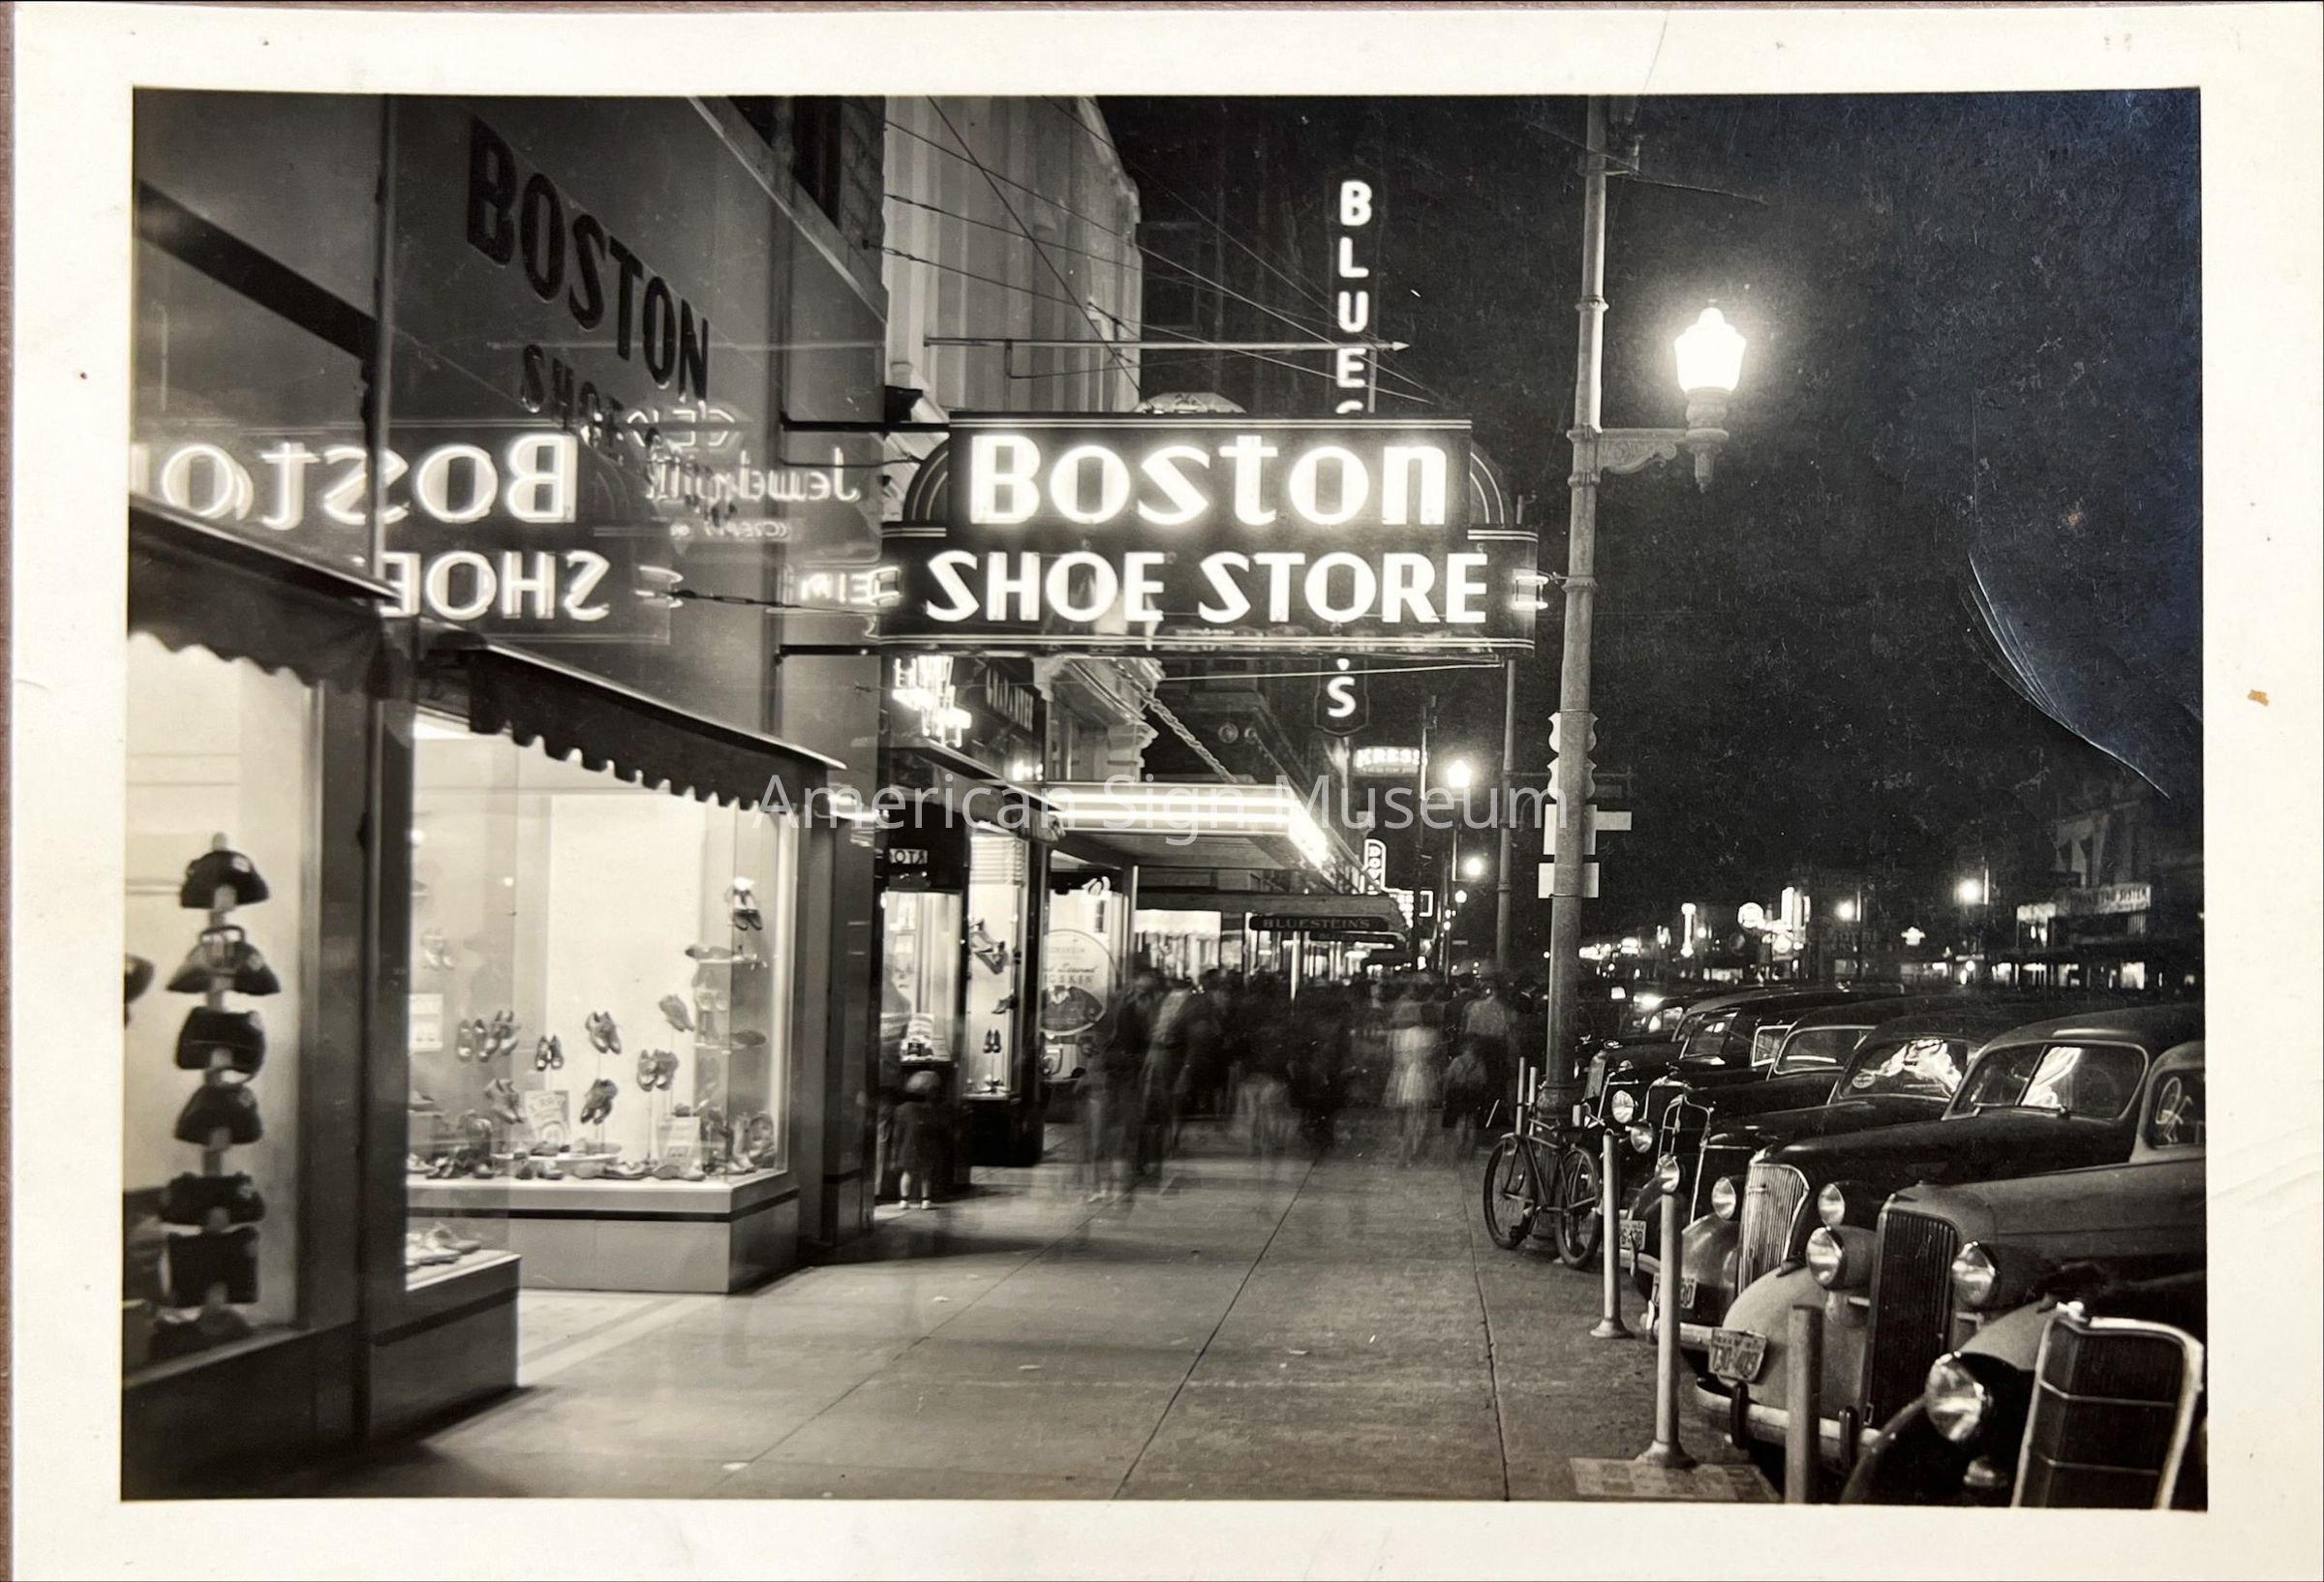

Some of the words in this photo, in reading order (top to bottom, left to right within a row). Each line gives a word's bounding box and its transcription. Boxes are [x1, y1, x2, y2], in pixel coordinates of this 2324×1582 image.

[467, 114, 709, 401] BOSTON
[968, 434, 1448, 525] Boston
[926, 549, 1165, 623] SHOE
[1198, 549, 1488, 624] STORE
